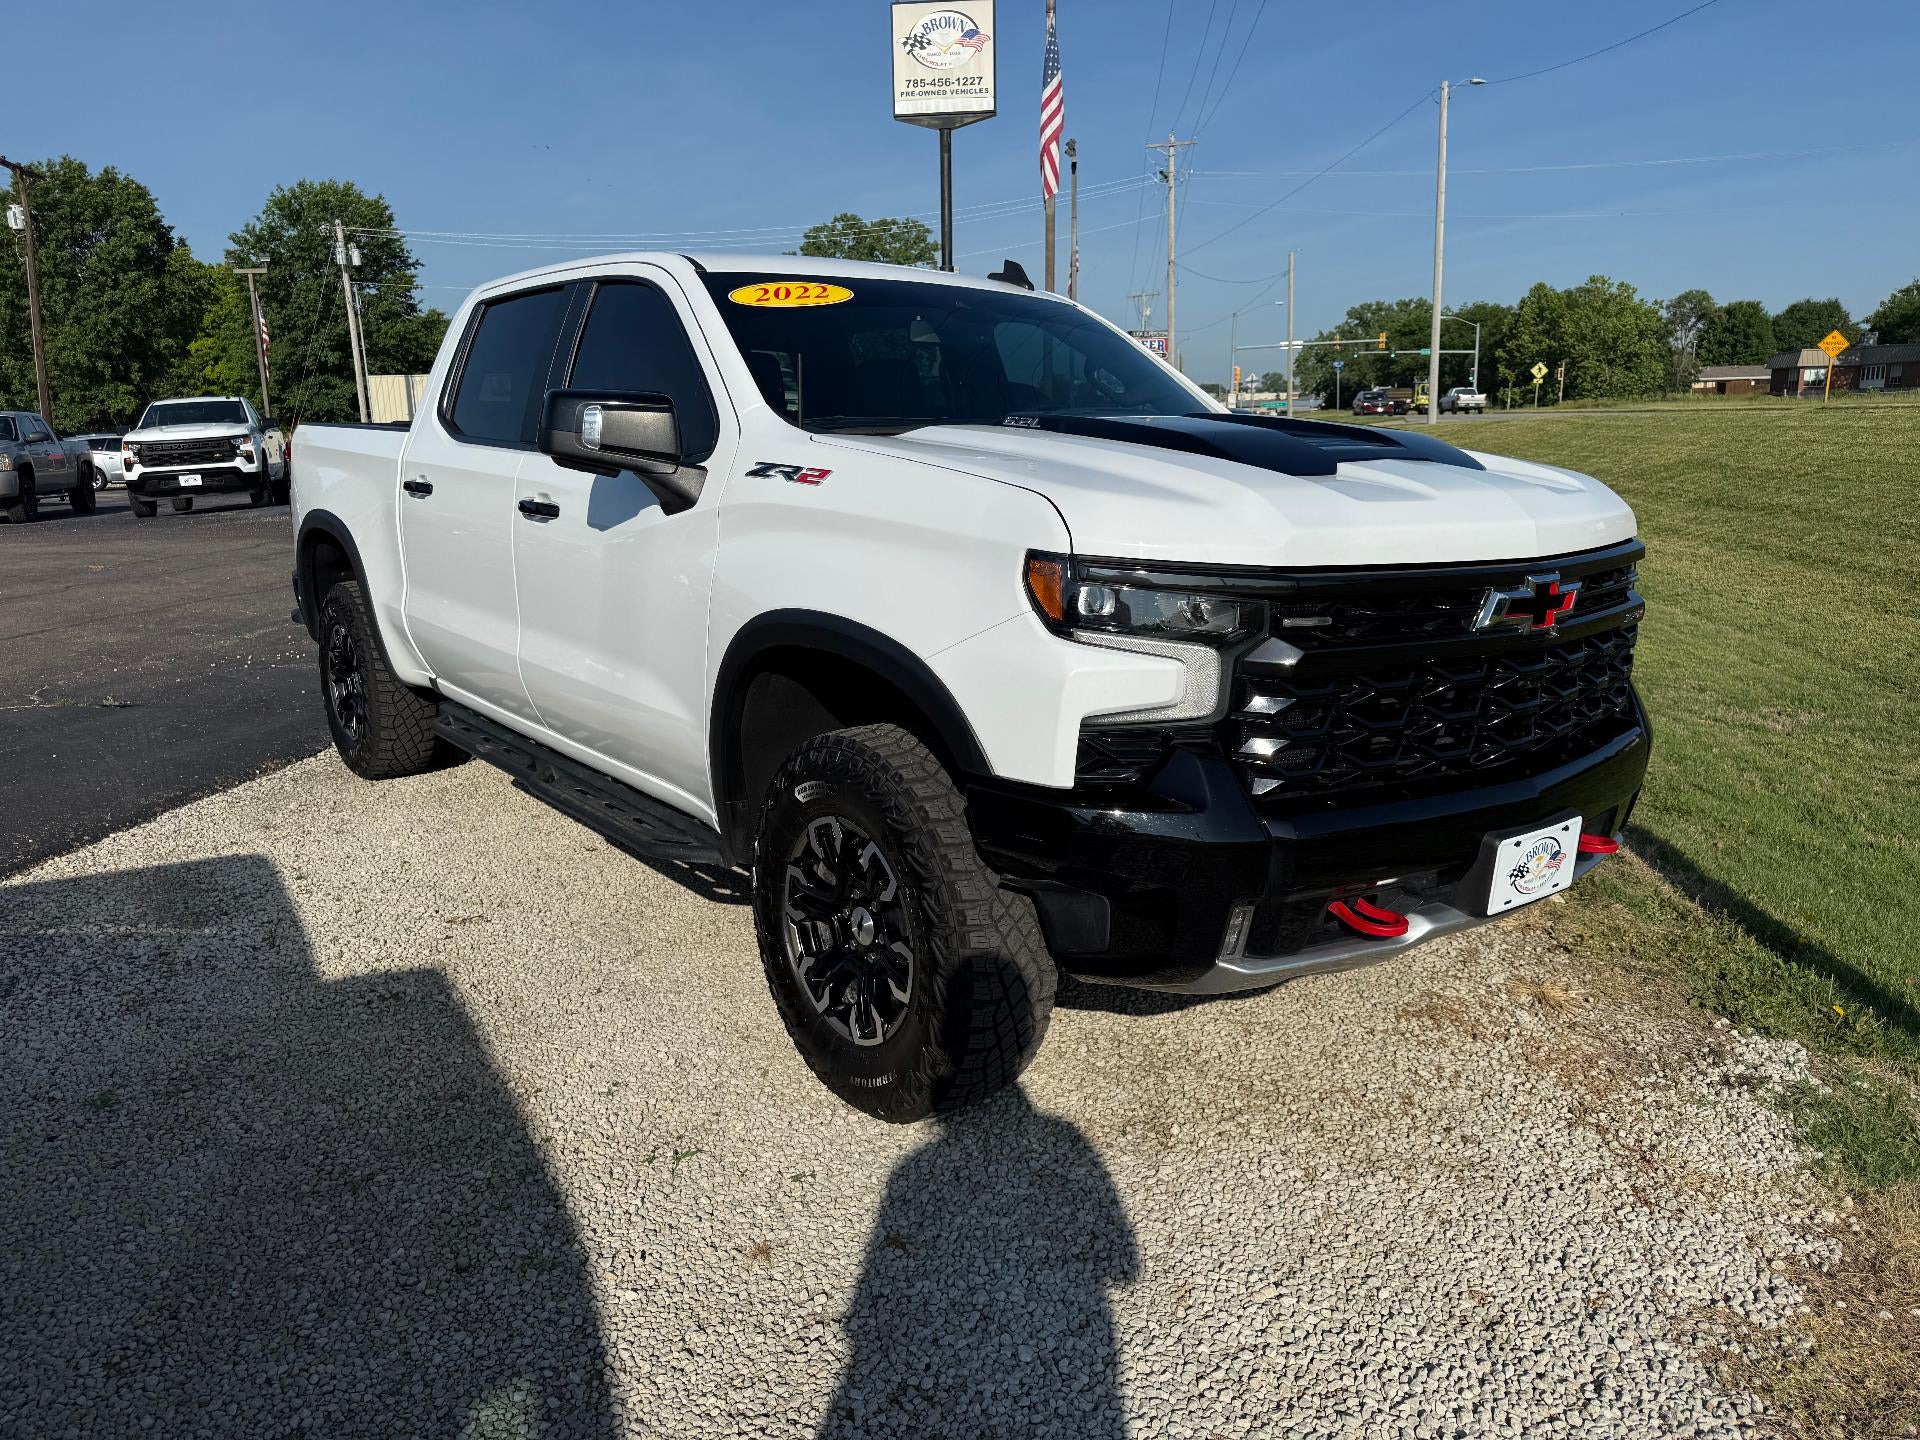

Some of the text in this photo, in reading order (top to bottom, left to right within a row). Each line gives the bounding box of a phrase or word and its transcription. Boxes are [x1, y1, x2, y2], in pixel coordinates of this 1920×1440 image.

[921, 16, 967, 35] BROWN
[905, 76, 983, 88] 785-456-1227
[900, 87, 989, 98] PRE-OWNED VEHICLES
[754, 285, 829, 302] 2022
[745, 461, 833, 486] ZR2
[1525, 841, 1556, 863] BROWN
